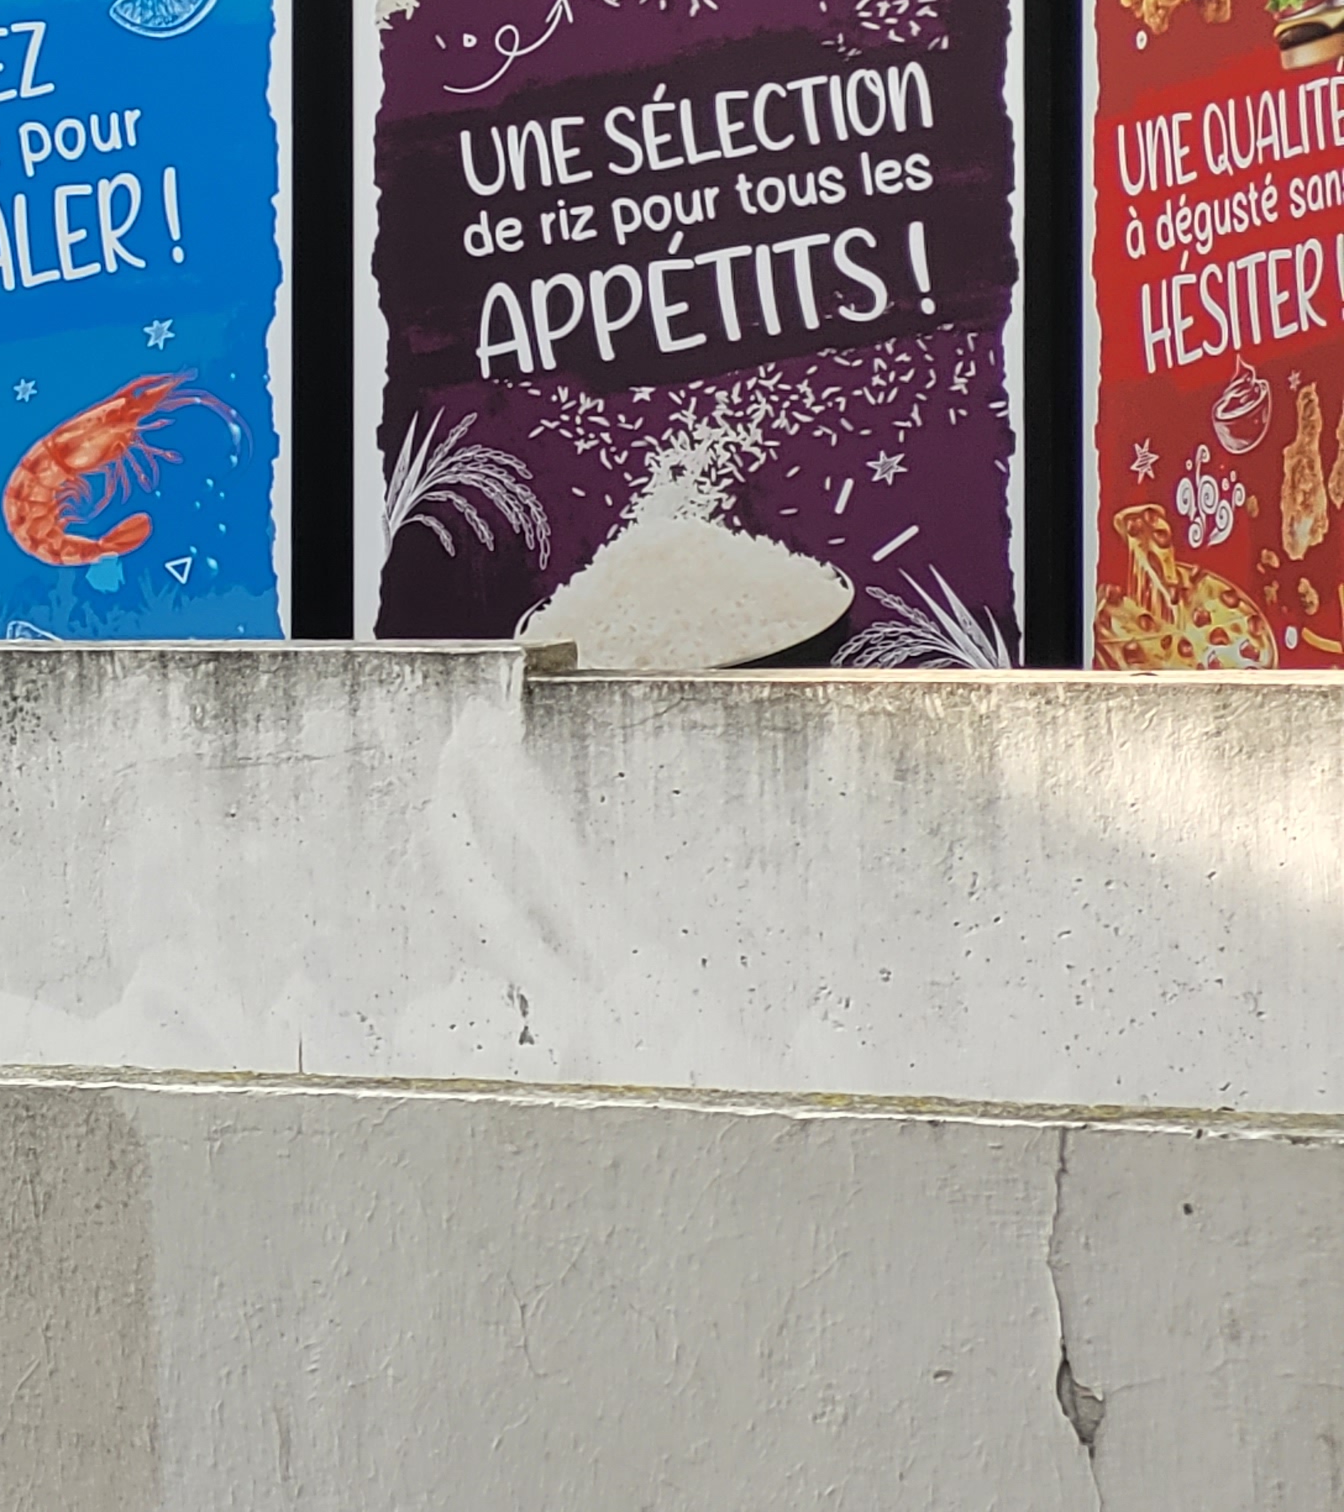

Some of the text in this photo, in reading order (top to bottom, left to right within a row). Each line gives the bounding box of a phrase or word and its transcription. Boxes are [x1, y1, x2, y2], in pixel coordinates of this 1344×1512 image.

[19, 109, 142, 177] pour
[460, 61, 934, 196] UNE SÉLECTION
[1117, 112, 1198, 196] UNE
[463, 151, 934, 257] de riz pour tous les
[1125, 169, 1344, 260] à dégusté san
[475, 227, 889, 379] APPÉTITS
[1141, 250, 1327, 374] HÉSITER
